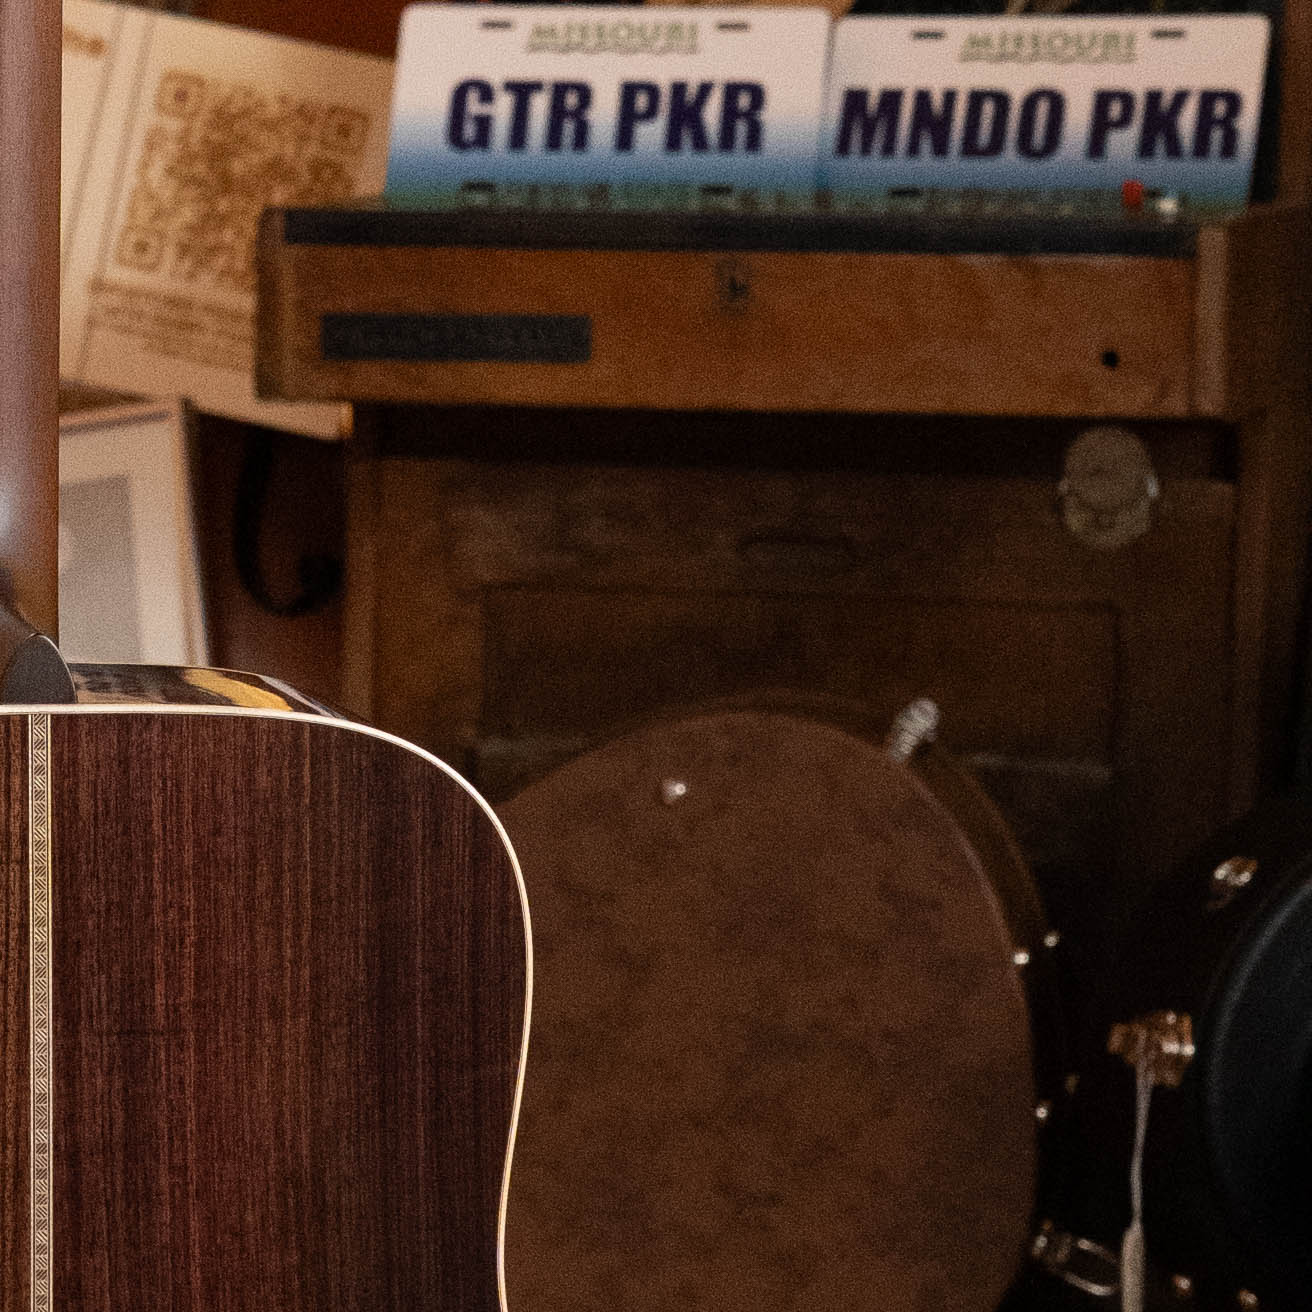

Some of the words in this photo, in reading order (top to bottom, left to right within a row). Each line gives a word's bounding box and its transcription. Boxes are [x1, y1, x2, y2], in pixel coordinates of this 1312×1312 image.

[444, 78, 593, 154] GTR
[614, 79, 767, 154] PKR
[833, 88, 1067, 160] MNDO
[1087, 88, 1244, 160] PKR
